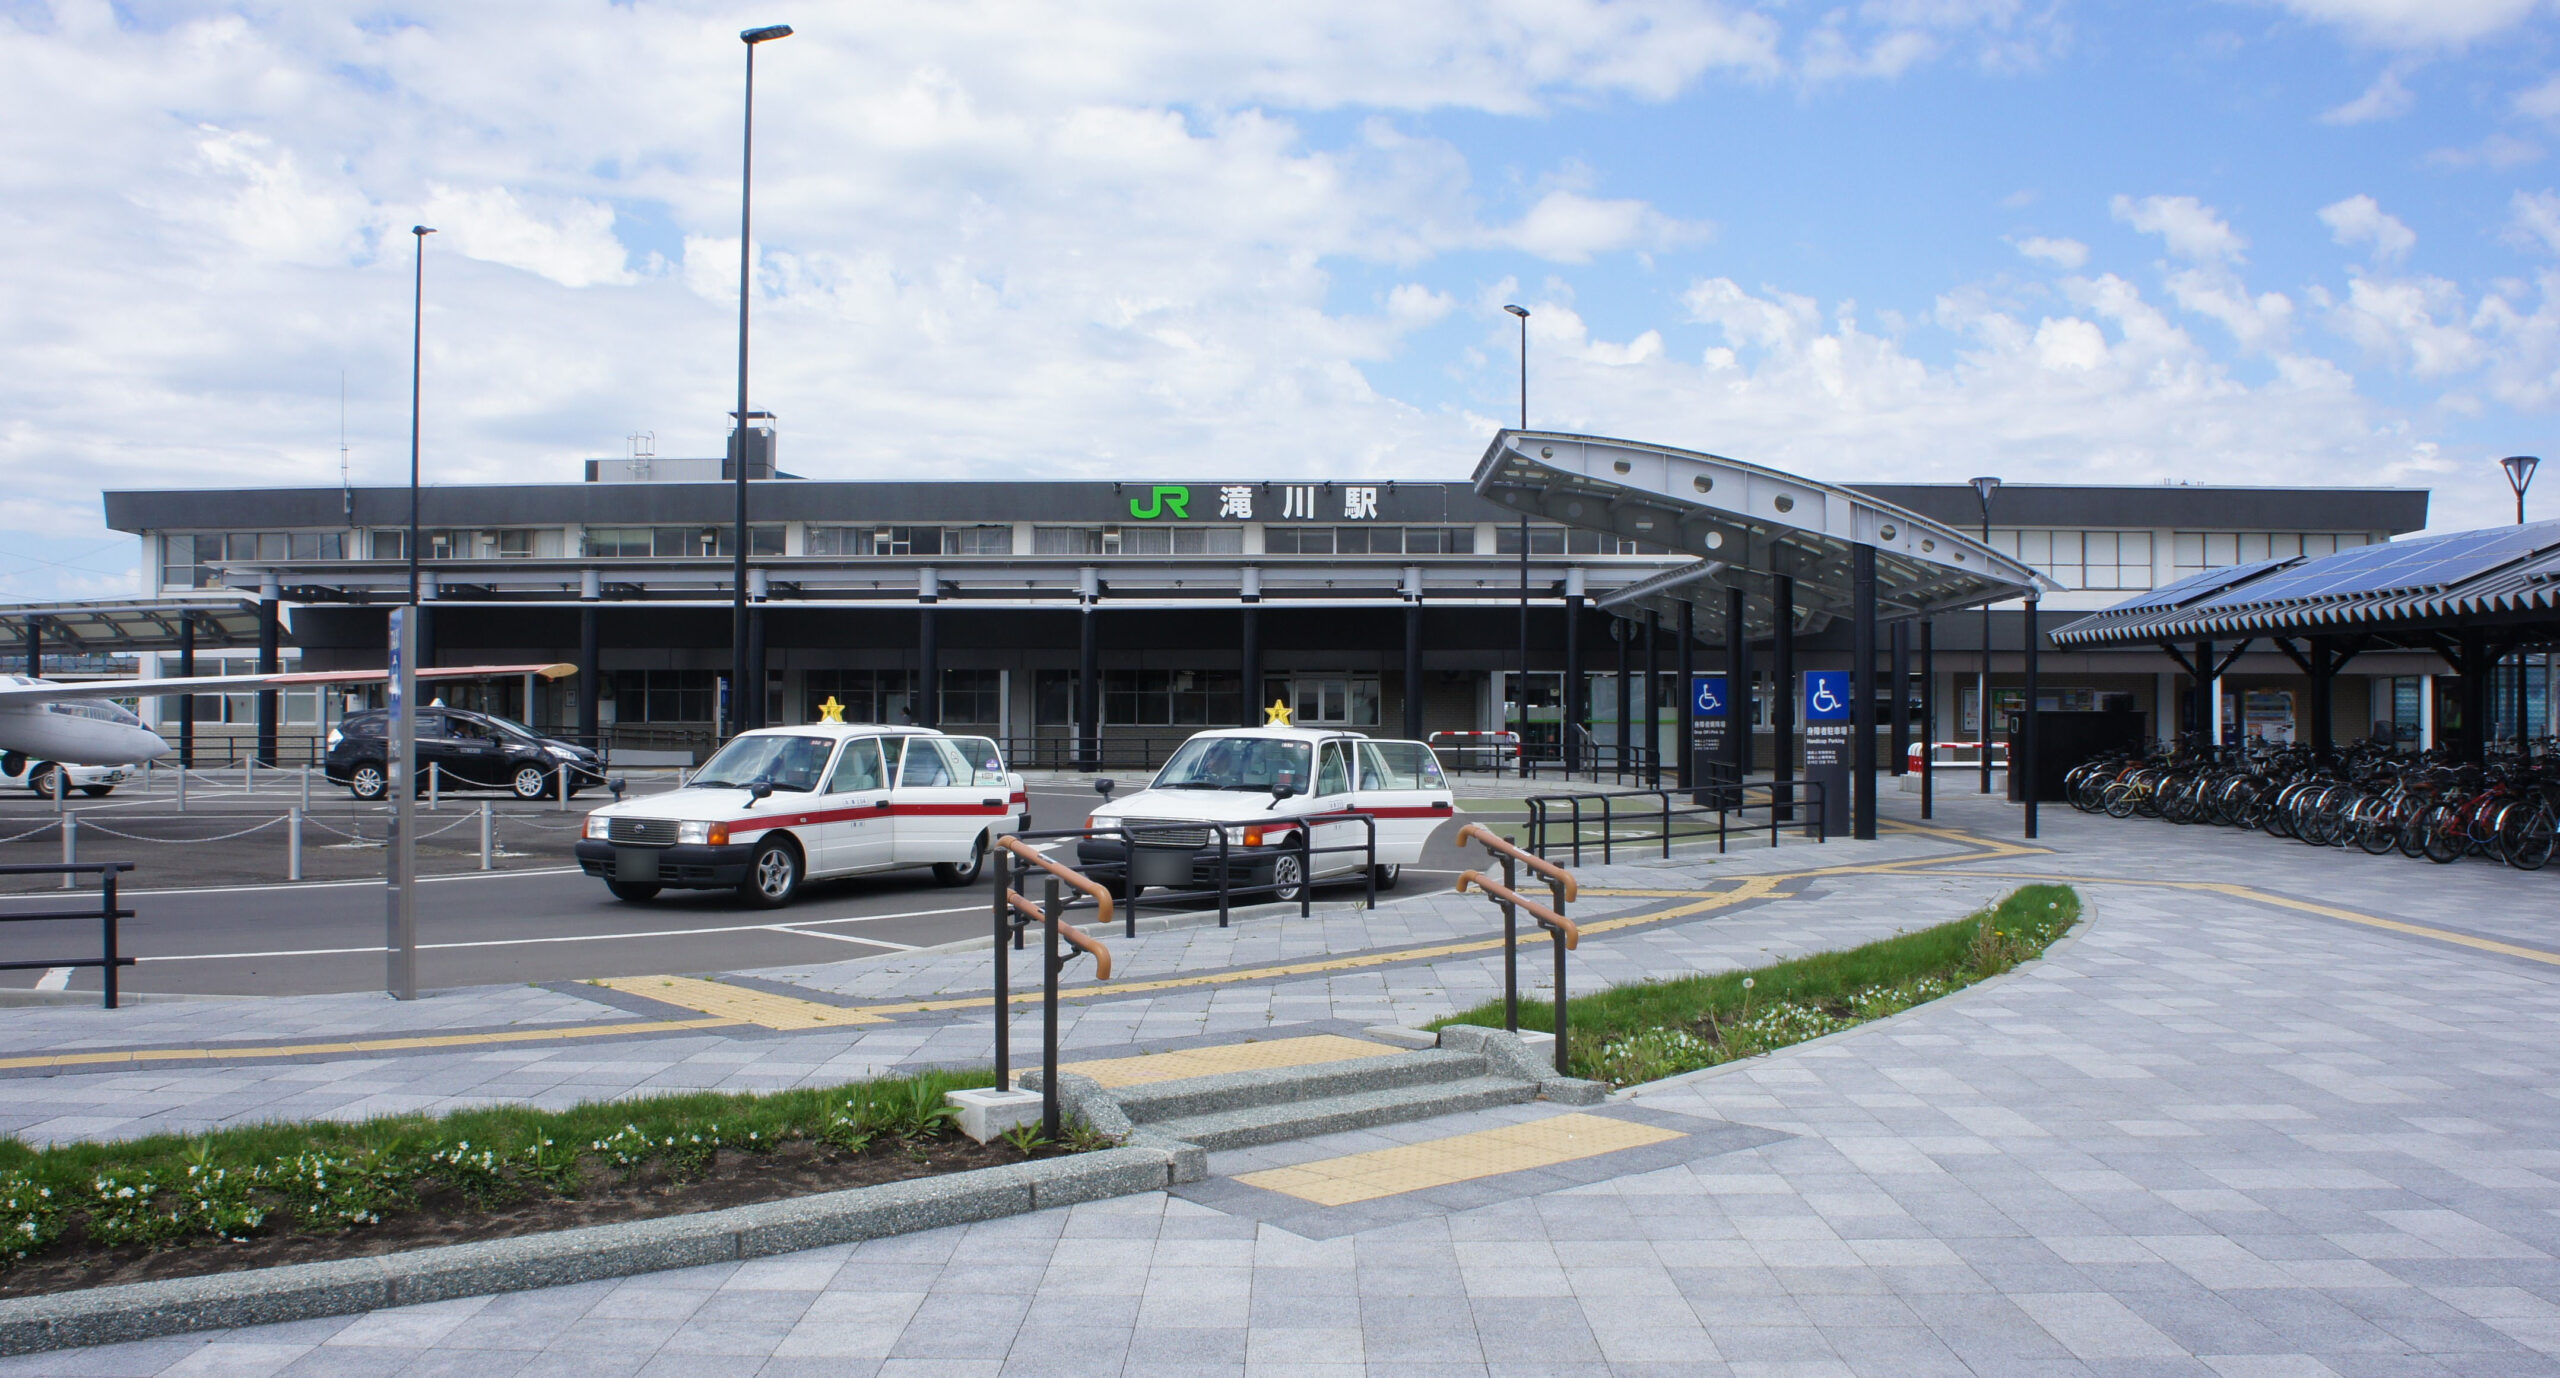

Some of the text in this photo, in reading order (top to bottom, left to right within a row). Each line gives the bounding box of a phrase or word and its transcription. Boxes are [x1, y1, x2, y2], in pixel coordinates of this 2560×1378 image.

[1130, 486, 1189, 518] JR
[1219, 486, 1377, 519] 滝川駅
